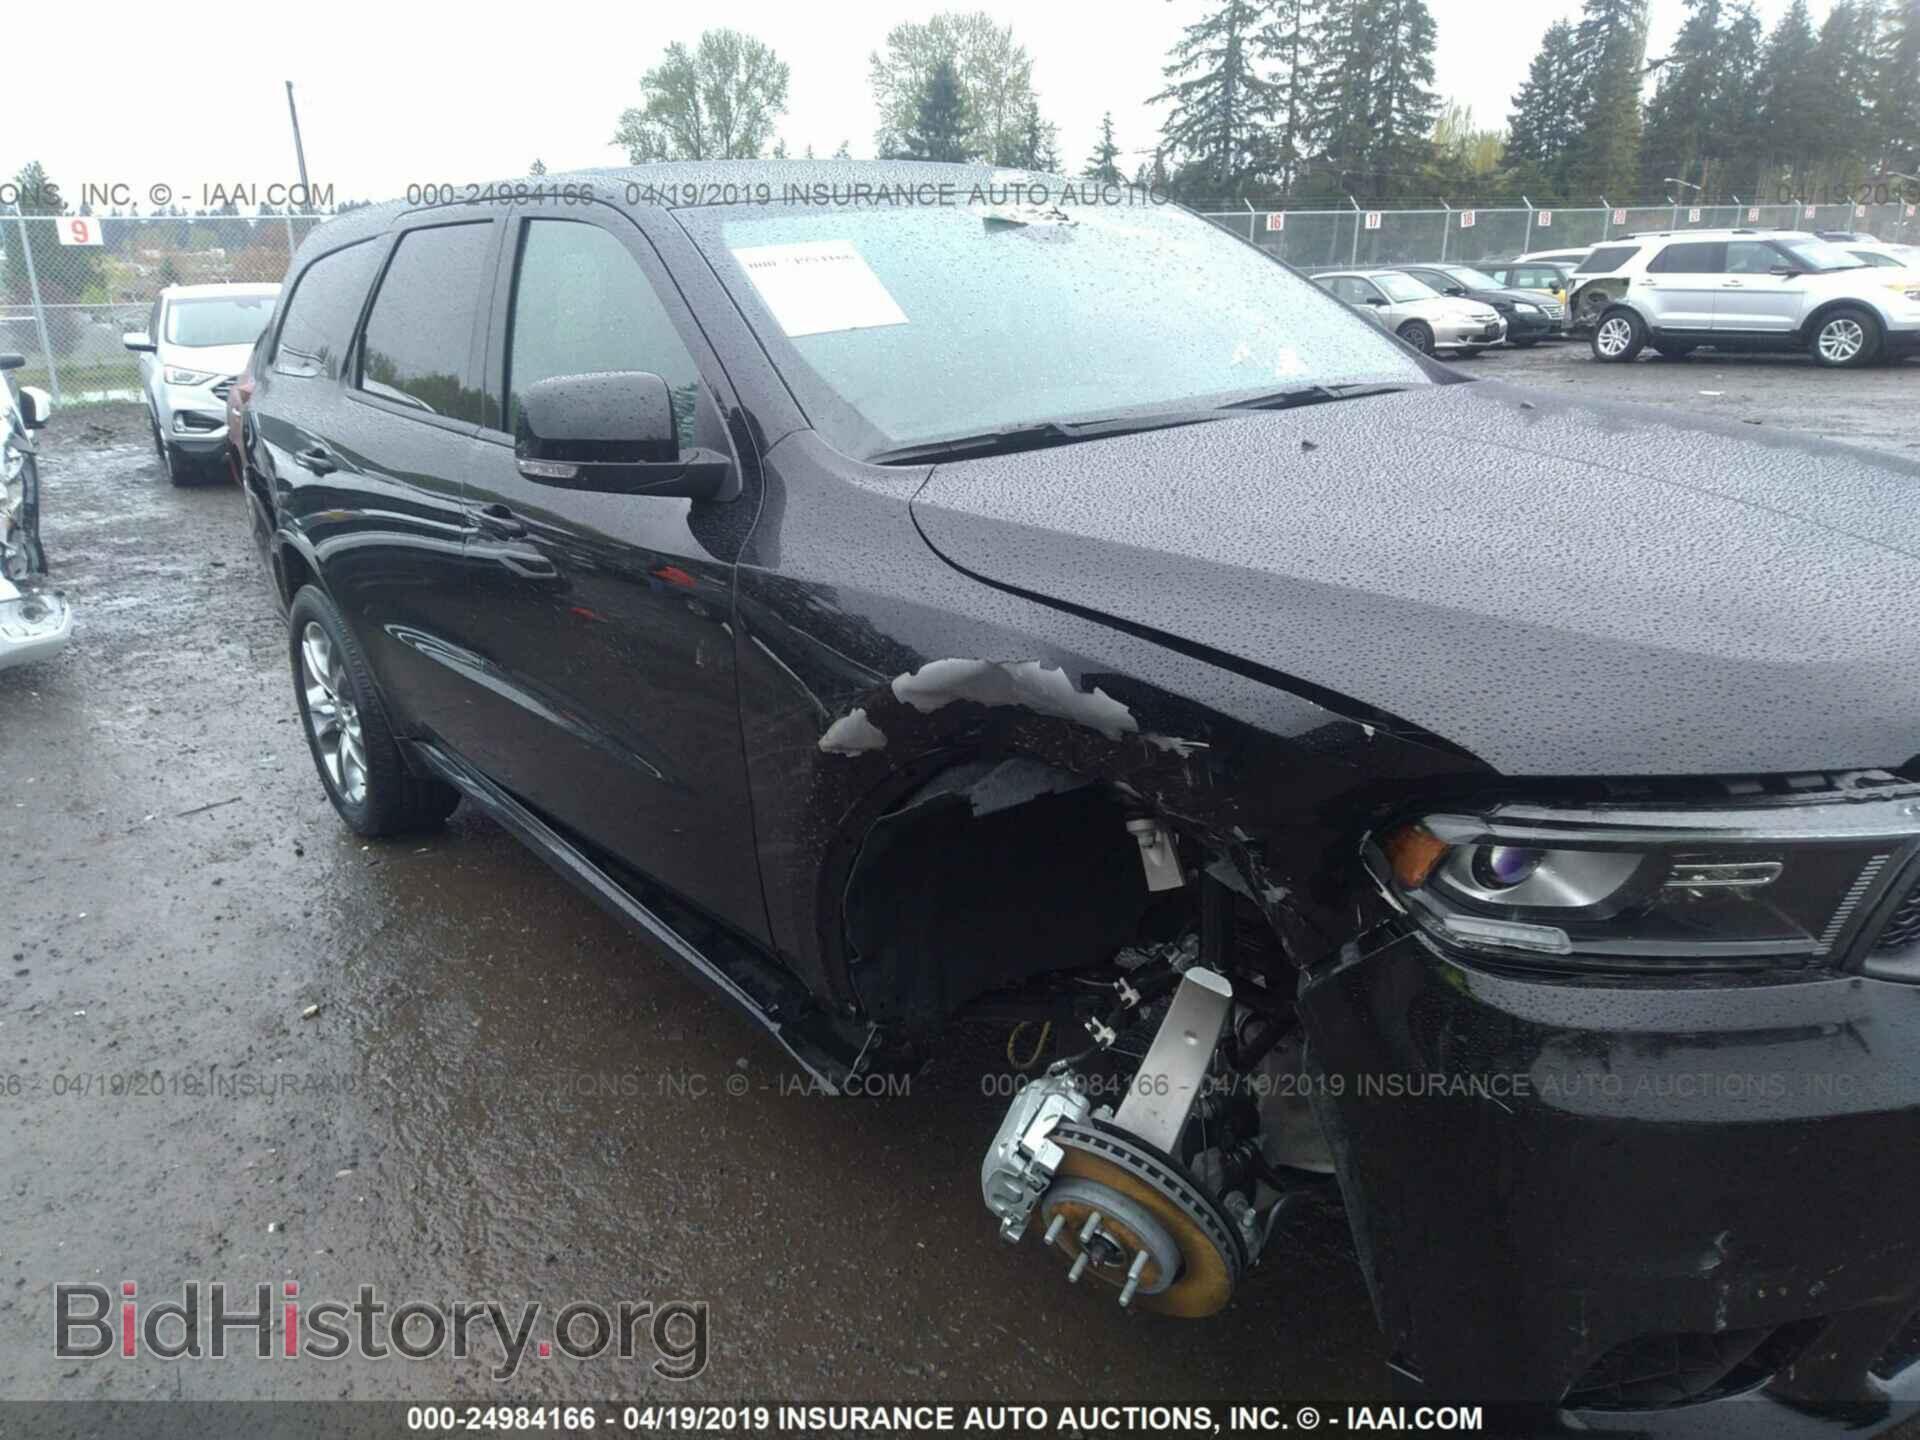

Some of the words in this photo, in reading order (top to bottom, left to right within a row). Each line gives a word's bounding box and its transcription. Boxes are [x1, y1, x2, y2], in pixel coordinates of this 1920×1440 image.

[1269, 214, 1281, 230] 16
[1369, 212, 1379, 227] 17
[70, 220, 89, 243] 9
